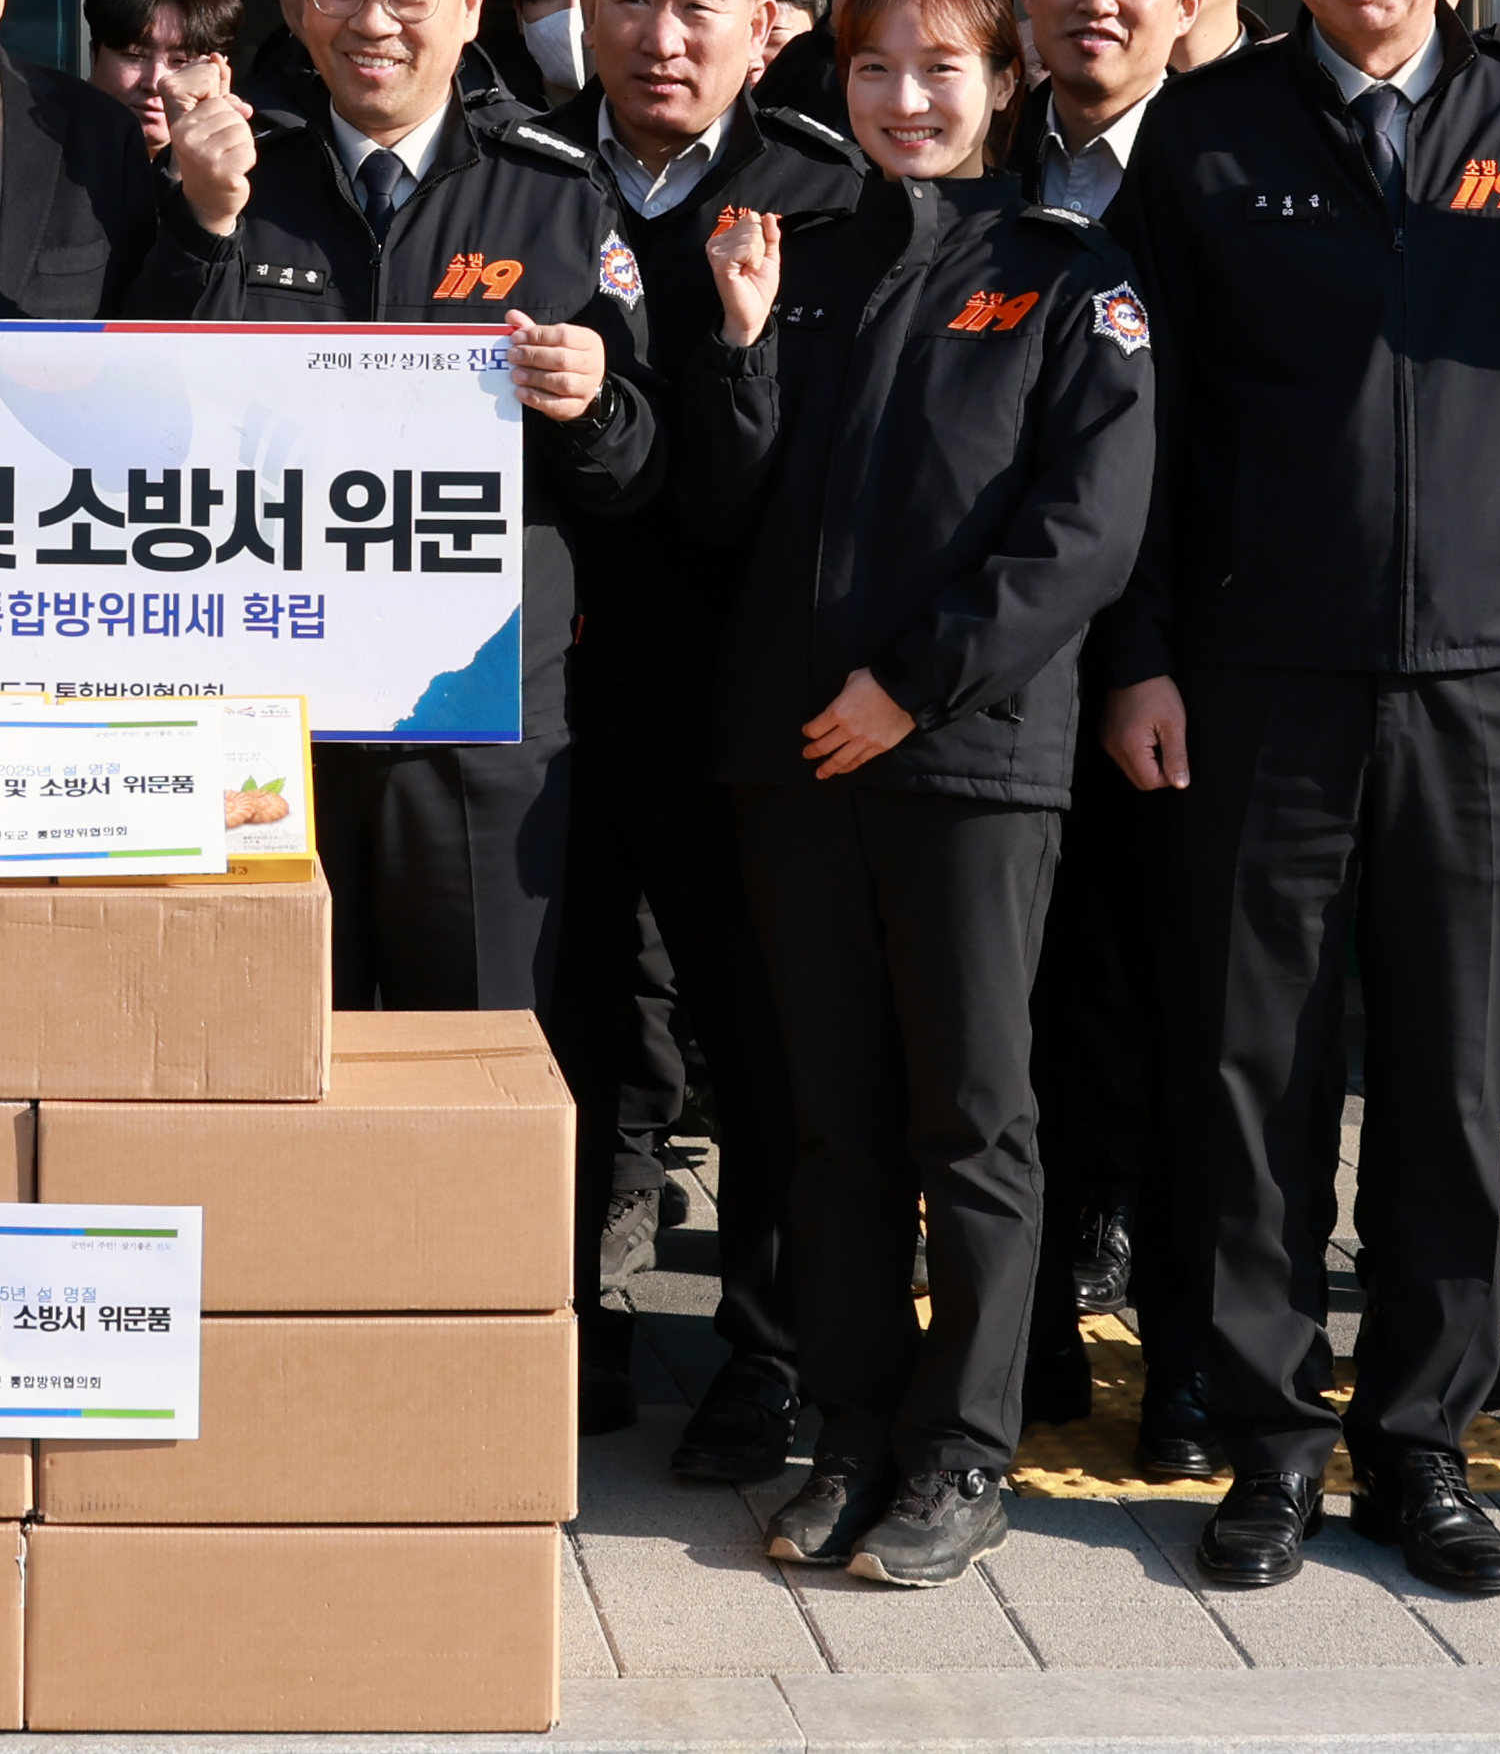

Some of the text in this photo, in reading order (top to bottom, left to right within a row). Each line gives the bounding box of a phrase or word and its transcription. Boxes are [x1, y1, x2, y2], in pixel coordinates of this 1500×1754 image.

[1465, 159, 1498, 176] 소방
[449, 253, 485, 268] 소방
[432, 259, 524, 299] 119
[947, 291, 1040, 332] 119
[309, 353, 351, 369] 군민이
[362, 354, 396, 369] 주인!
[402, 354, 459, 370] 살기좋은
[36, 468, 303, 572] 소방서
[325, 470, 506, 573] 위문
[243, 593, 324, 638] 확립
[62, 763, 78, 776] 설
[88, 762, 121, 775] 명절
[5, 779, 26, 797] 및
[41, 777, 109, 797] 소방서
[124, 776, 193, 793] 위문품
[38, 827, 126, 838] 통합방위협의회
[36, 1286, 53, 1303] 설
[63, 1286, 97, 1303] 명절
[14, 1305, 85, 1332] 소방서
[99, 1306, 171, 1332] 위문품
[11, 1376, 100, 1388] 통합방위협의회
